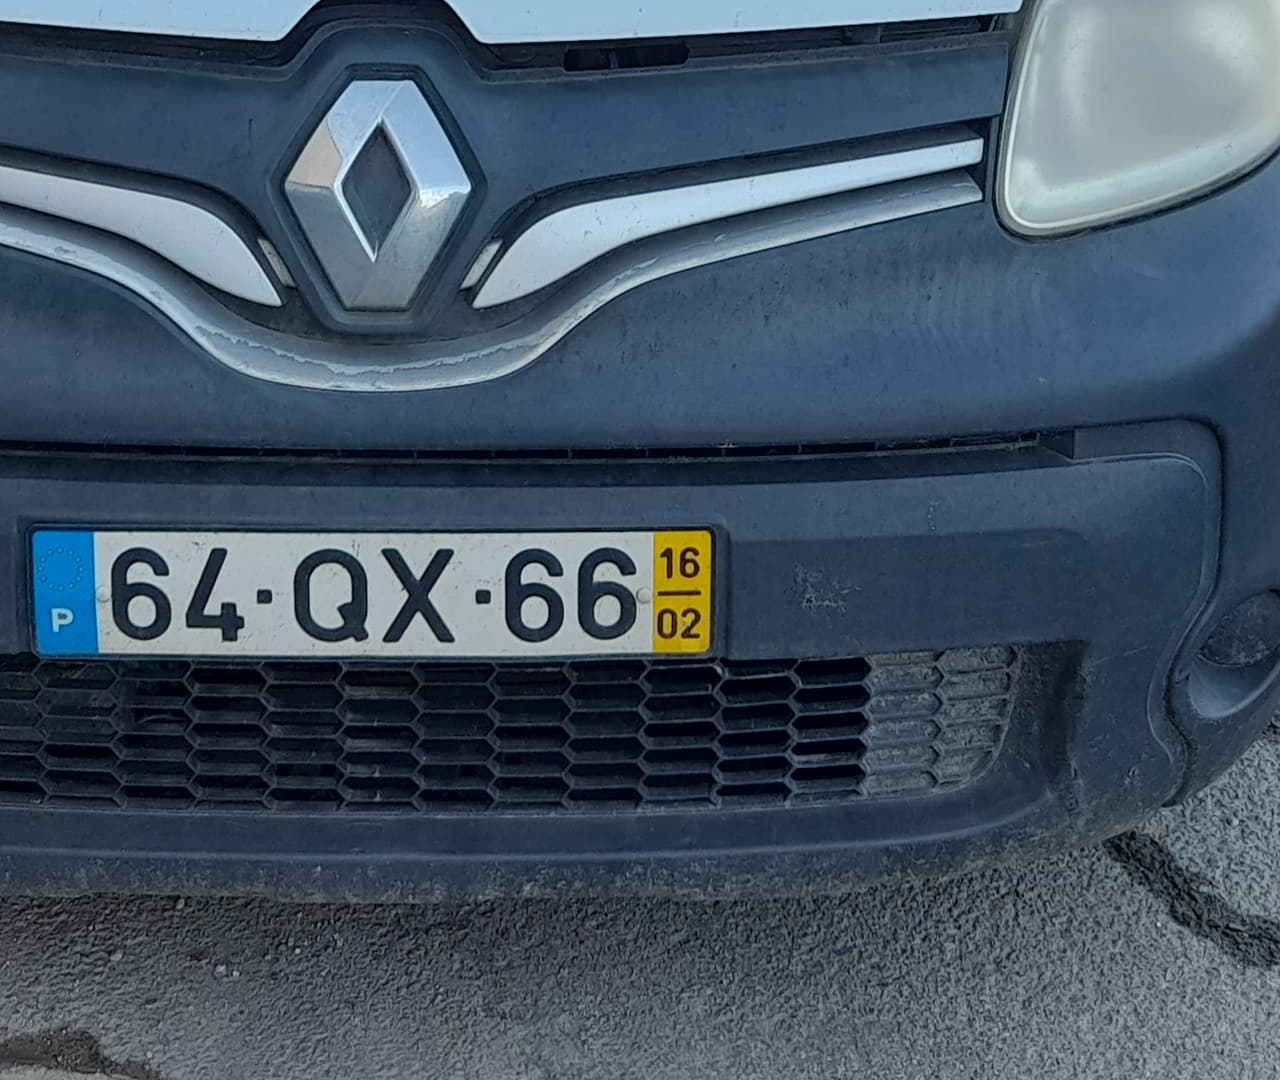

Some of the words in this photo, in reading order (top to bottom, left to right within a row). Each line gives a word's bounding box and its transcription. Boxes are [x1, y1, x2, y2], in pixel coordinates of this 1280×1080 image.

[659, 546, 701, 579] 16
[51, 608, 74, 633] P
[655, 608, 703, 642] 02
